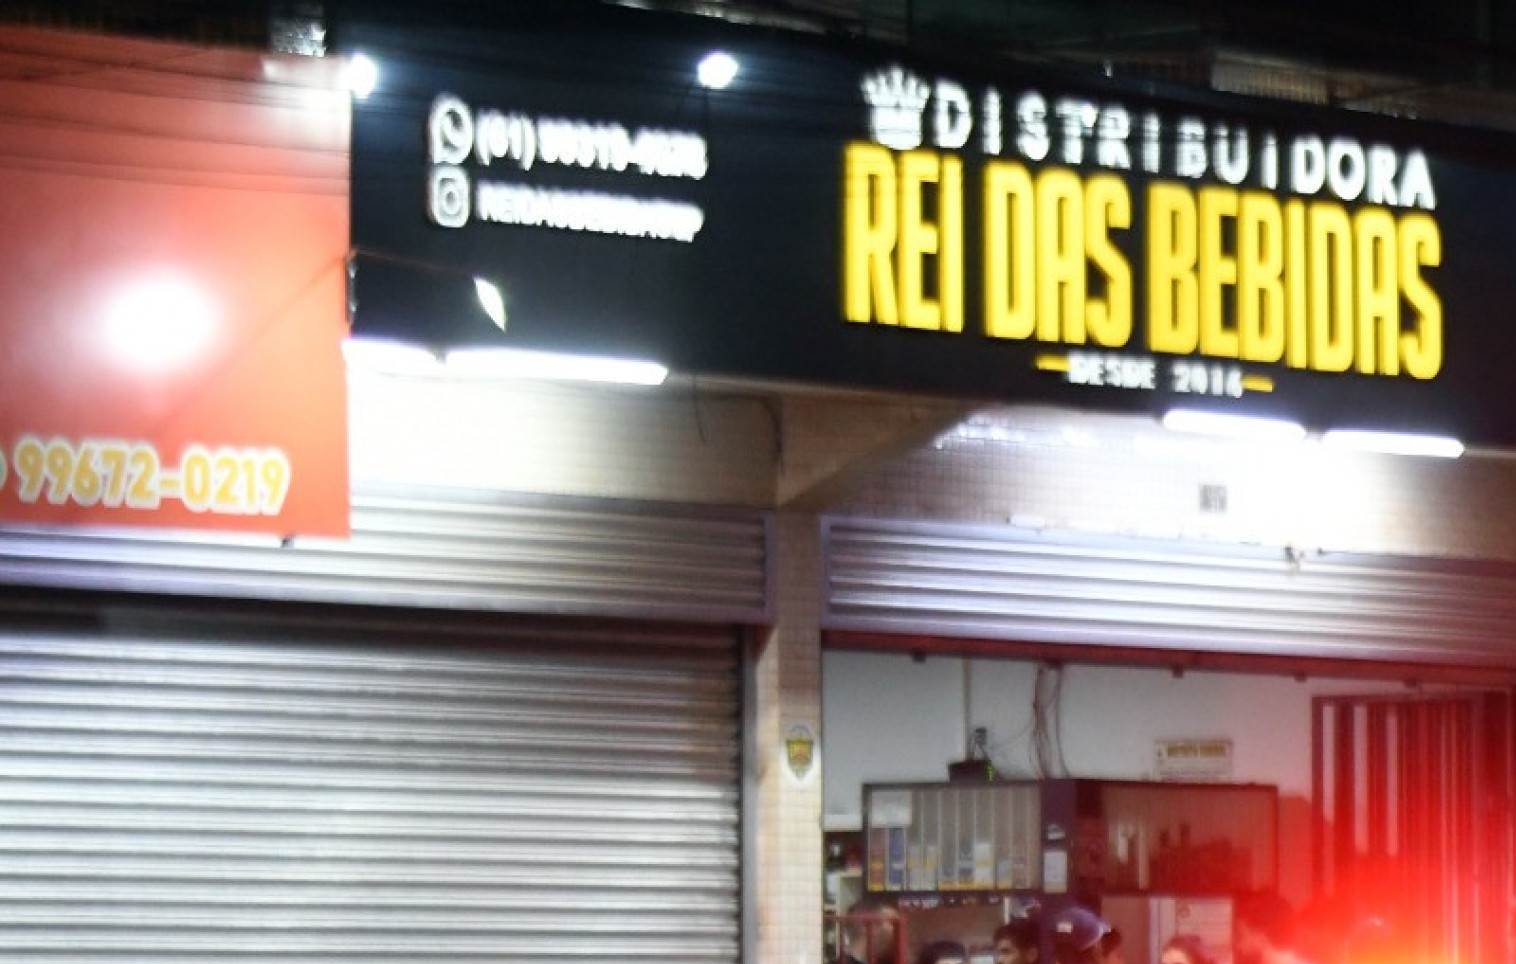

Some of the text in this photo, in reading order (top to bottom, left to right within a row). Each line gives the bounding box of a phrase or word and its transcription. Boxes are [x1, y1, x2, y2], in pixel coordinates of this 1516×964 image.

[933, 77, 1438, 211] DISTRIBUIDORA
[843, 140, 1443, 381] REI DAS BEBIDAS
[1066, 351, 1156, 390] DESDE
[15, 437, 290, 516] 99672-0219
